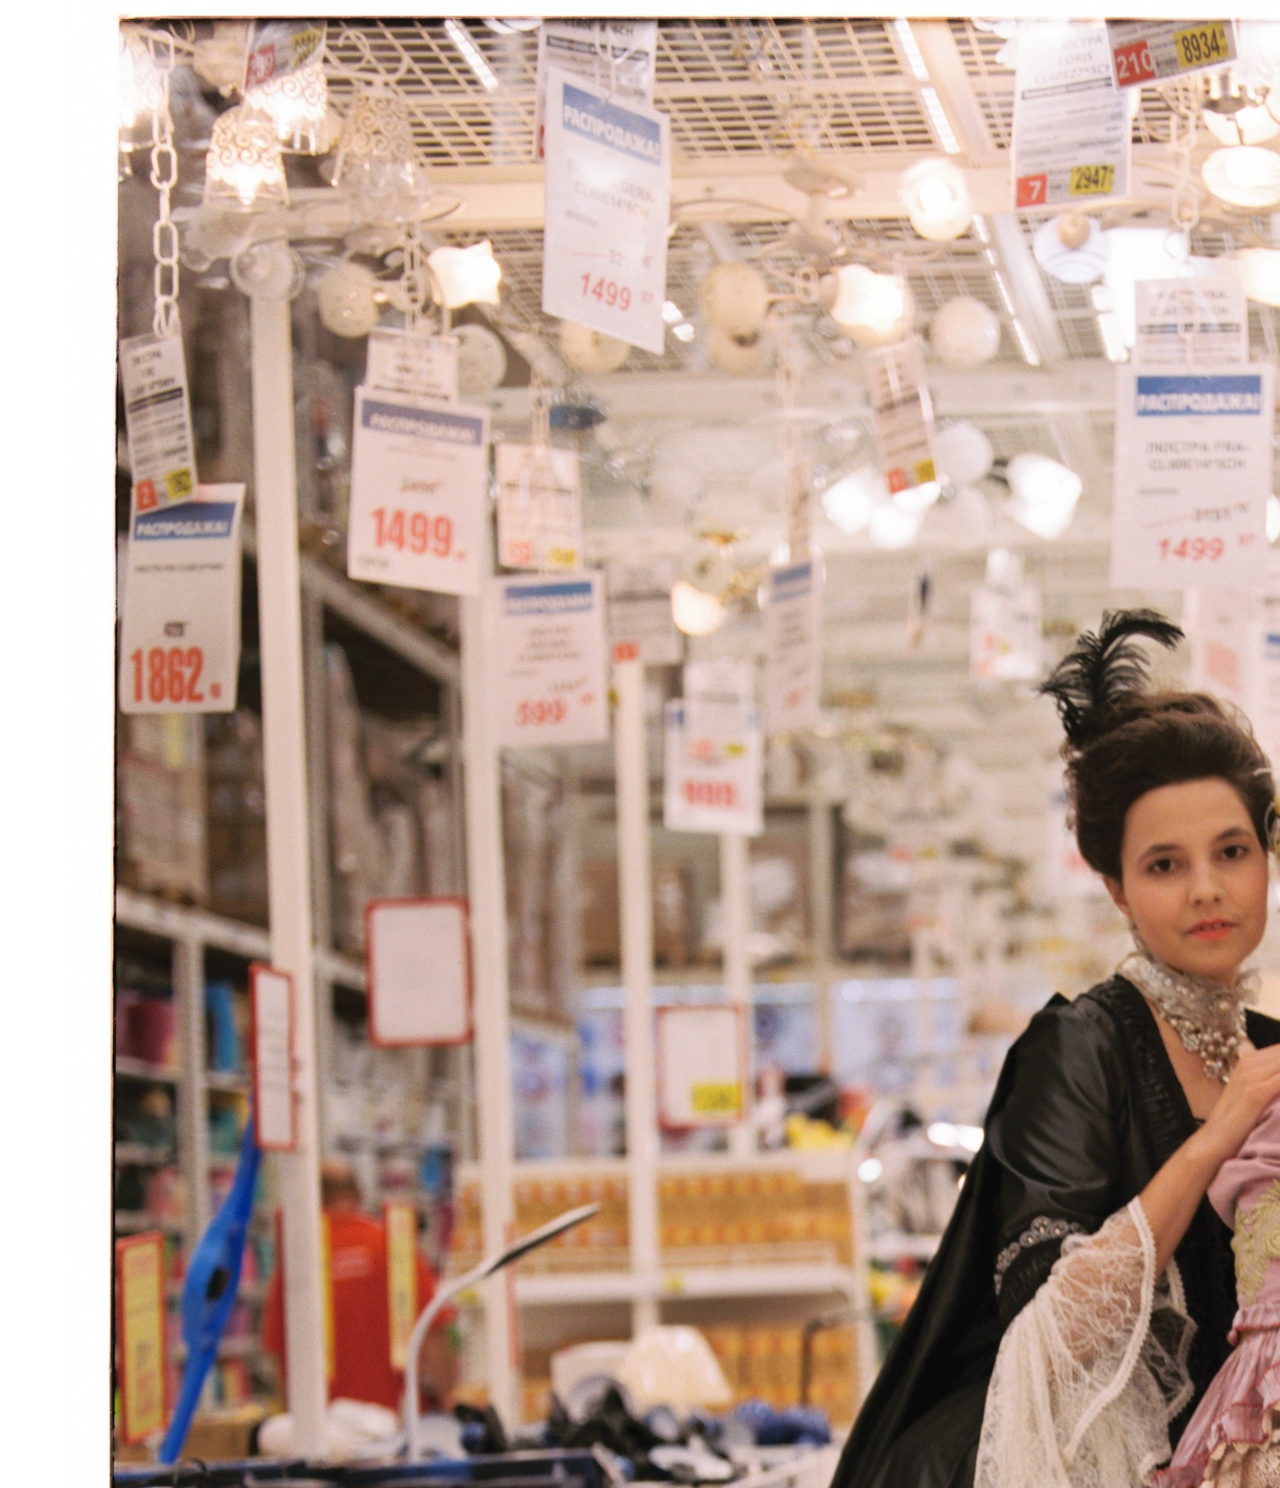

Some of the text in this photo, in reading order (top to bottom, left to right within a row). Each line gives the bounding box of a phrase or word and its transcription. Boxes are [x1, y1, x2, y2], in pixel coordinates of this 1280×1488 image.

[1181, 29, 1221, 63] 8934
[563, 103, 660, 159] РАСПРОДАЖА!
[1028, 180, 1042, 201] 7
[1075, 165, 1109, 191] 2947
[580, 271, 632, 313] 1499
[1136, 393, 1261, 412] РАСПРОДАЖА!
[369, 411, 477, 444] РАСПРОДАЖА!
[135, 520, 229, 537] РАСПРОДАЖА!
[369, 506, 455, 558] 1499
[1158, 535, 1226, 562] 1499
[130, 645, 206, 704] 1862
